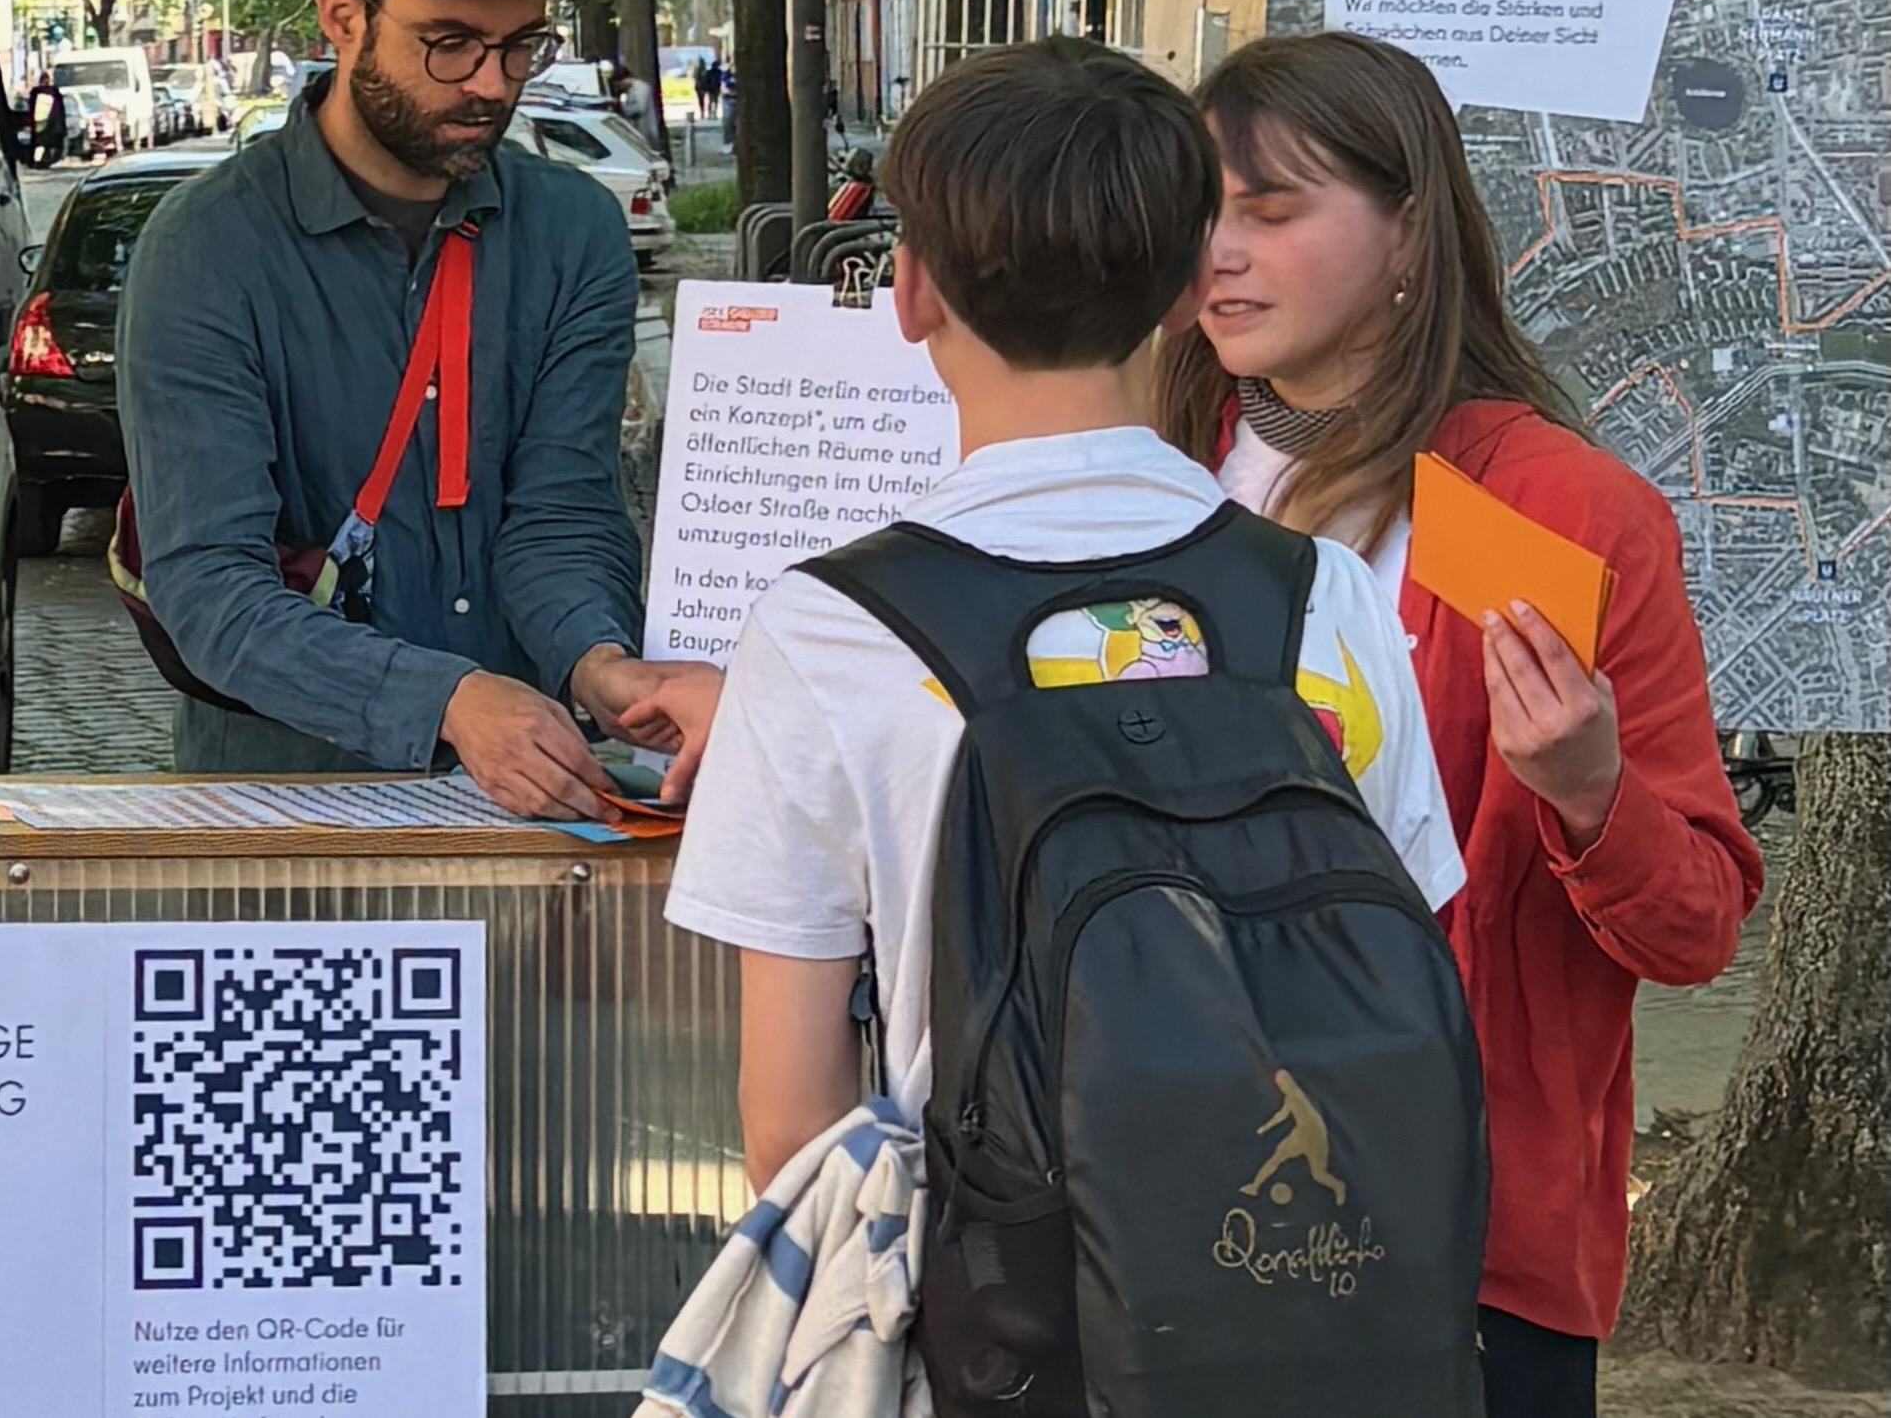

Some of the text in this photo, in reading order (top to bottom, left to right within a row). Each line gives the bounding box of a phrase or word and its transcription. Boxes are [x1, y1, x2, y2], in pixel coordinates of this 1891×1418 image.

[1462, 0, 1491, 16] die
[1496, 0, 1564, 17] Stärken
[1570, 1, 1603, 18] und
[1452, 27, 1483, 41] aus
[1490, 25, 1550, 43] Deiner
[1555, 27, 1599, 44] Sicht
[693, 372, 729, 393] Die
[737, 375, 791, 397] Stadt
[800, 378, 859, 400] Berlin
[689, 404, 721, 422] ein
[833, 416, 865, 431] um
[872, 412, 906, 433] die
[686, 432, 942, 466] öffentlichen Räume und
[684, 462, 931, 495] Einrichtungen im Umfel
[681, 492, 902, 524] Osloer Straße nachh
[675, 566, 776, 591] In den ko
[671, 598, 741, 621] Jahren
[134, 1316, 404, 1341] Nutze den QR-Code für
[133, 1351, 381, 1374] weitere Informationen
[133, 1383, 357, 1410] zum Projekt und die
